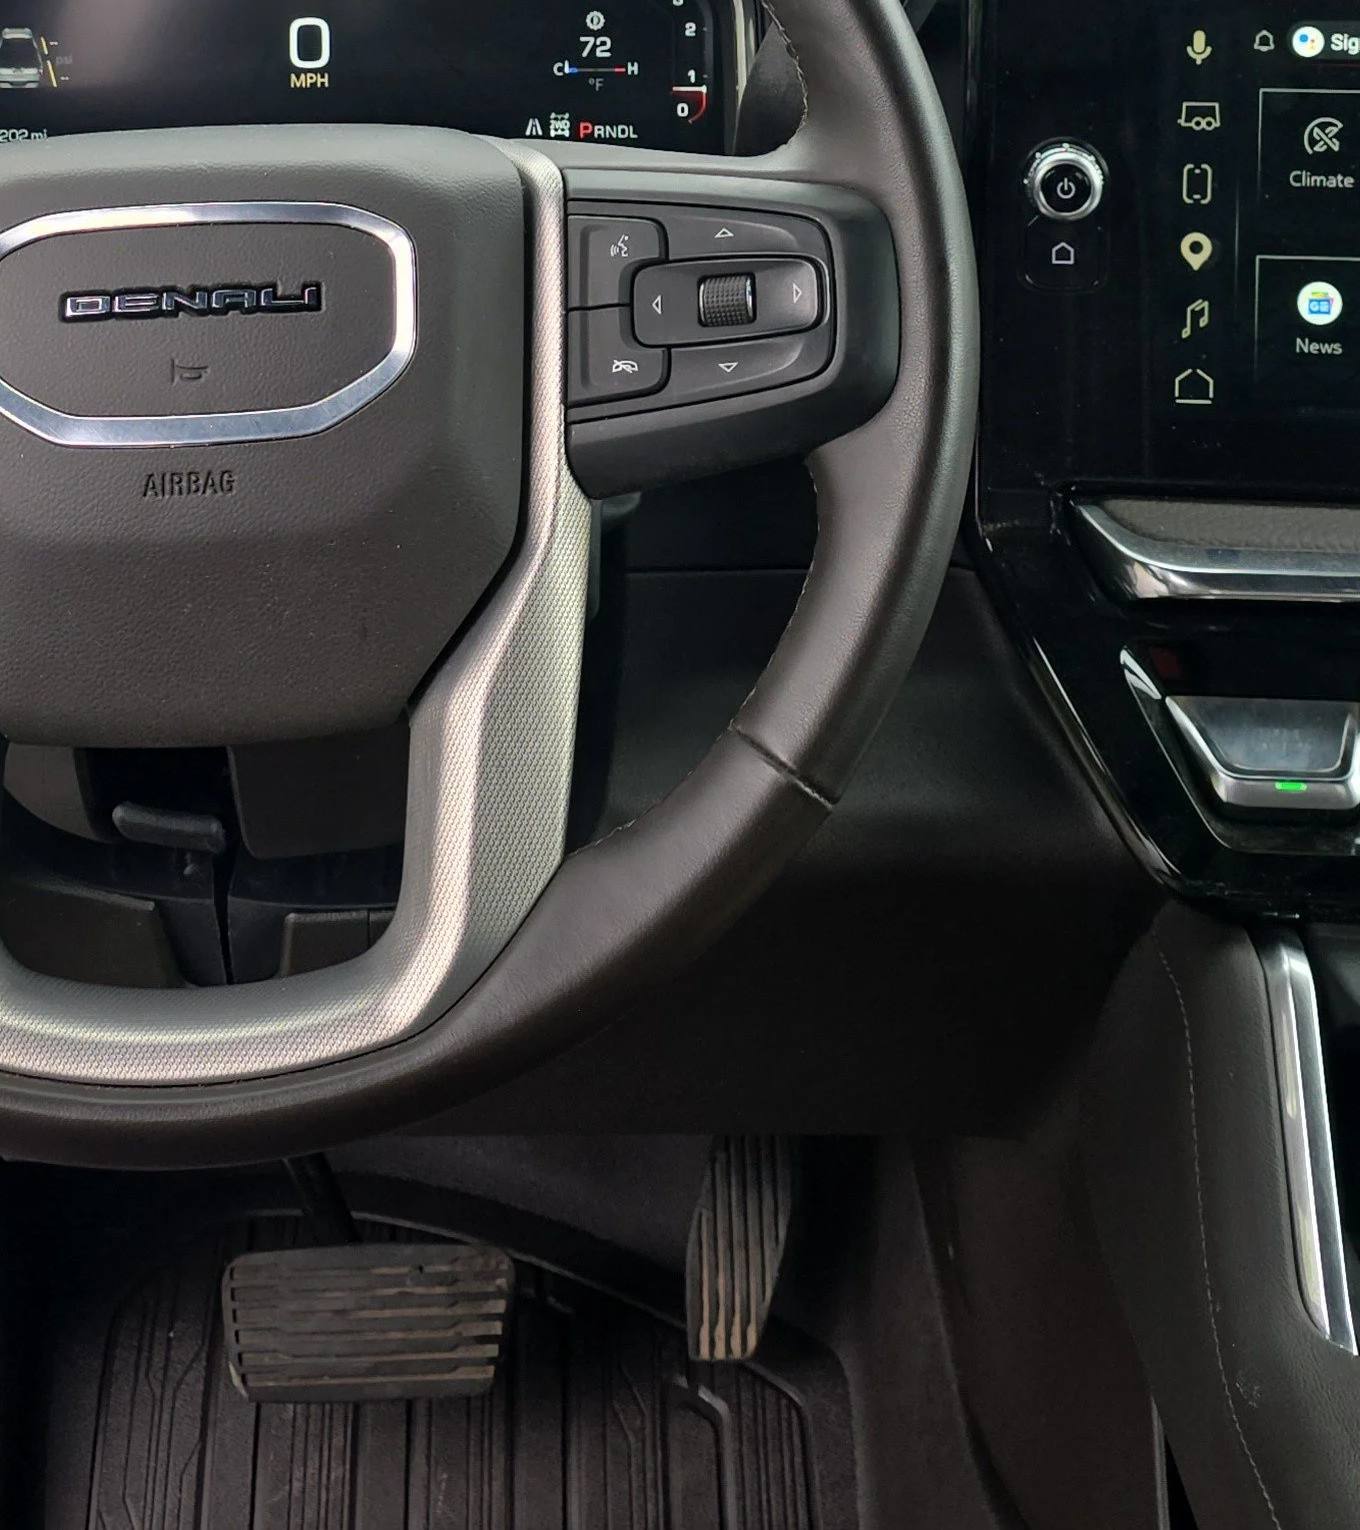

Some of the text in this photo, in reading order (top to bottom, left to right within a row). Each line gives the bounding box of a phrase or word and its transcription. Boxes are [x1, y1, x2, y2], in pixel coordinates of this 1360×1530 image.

[685, 22, 697, 37] 2
[289, 17, 330, 69] 0
[579, 36, 612, 58] 72
[290, 73, 329, 88] MPH
[687, 70, 696, 83] 1
[676, 103, 689, 118] 0
[31, 129, 48, 140] mi
[1289, 170, 1355, 188] Climate
[62, 283, 321, 320] DENALI
[1295, 337, 1343, 355] News
[142, 471, 236, 498] AIRBAG
